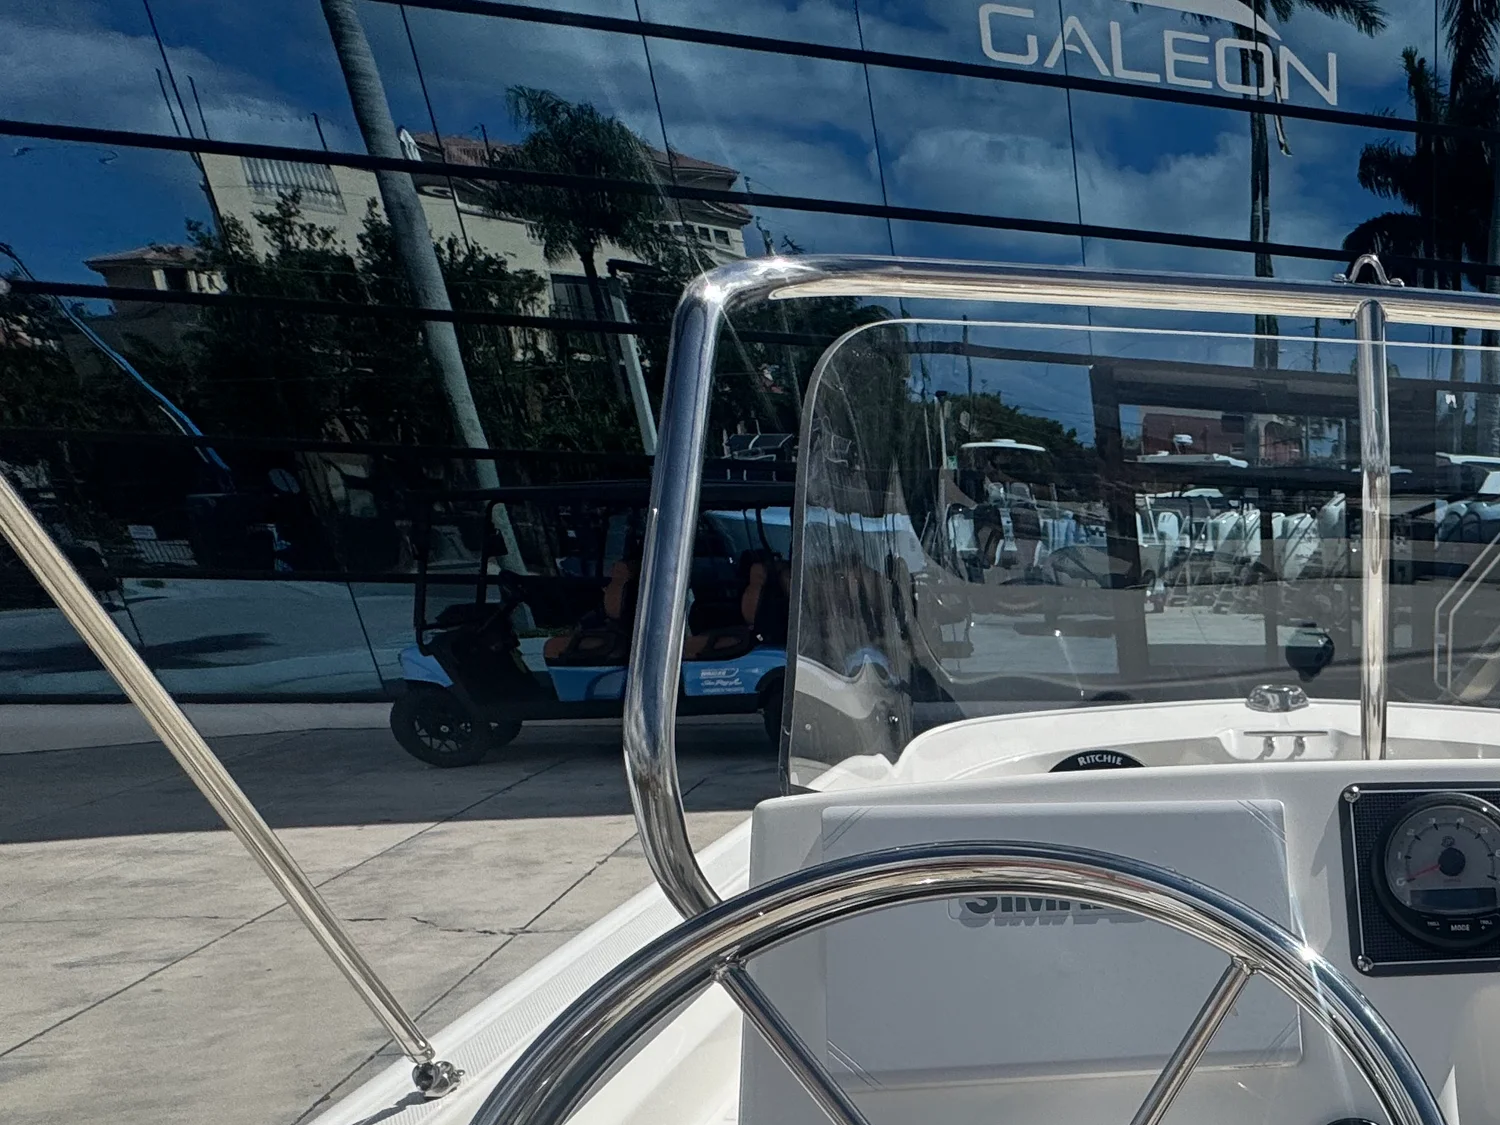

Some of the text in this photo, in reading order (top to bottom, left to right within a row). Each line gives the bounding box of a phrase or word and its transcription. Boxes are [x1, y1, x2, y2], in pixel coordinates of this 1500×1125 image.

[979, 3, 1338, 106] GALEON
[1077, 754, 1123, 767] RITCHIE
[1450, 924, 1471, 932] MODE
